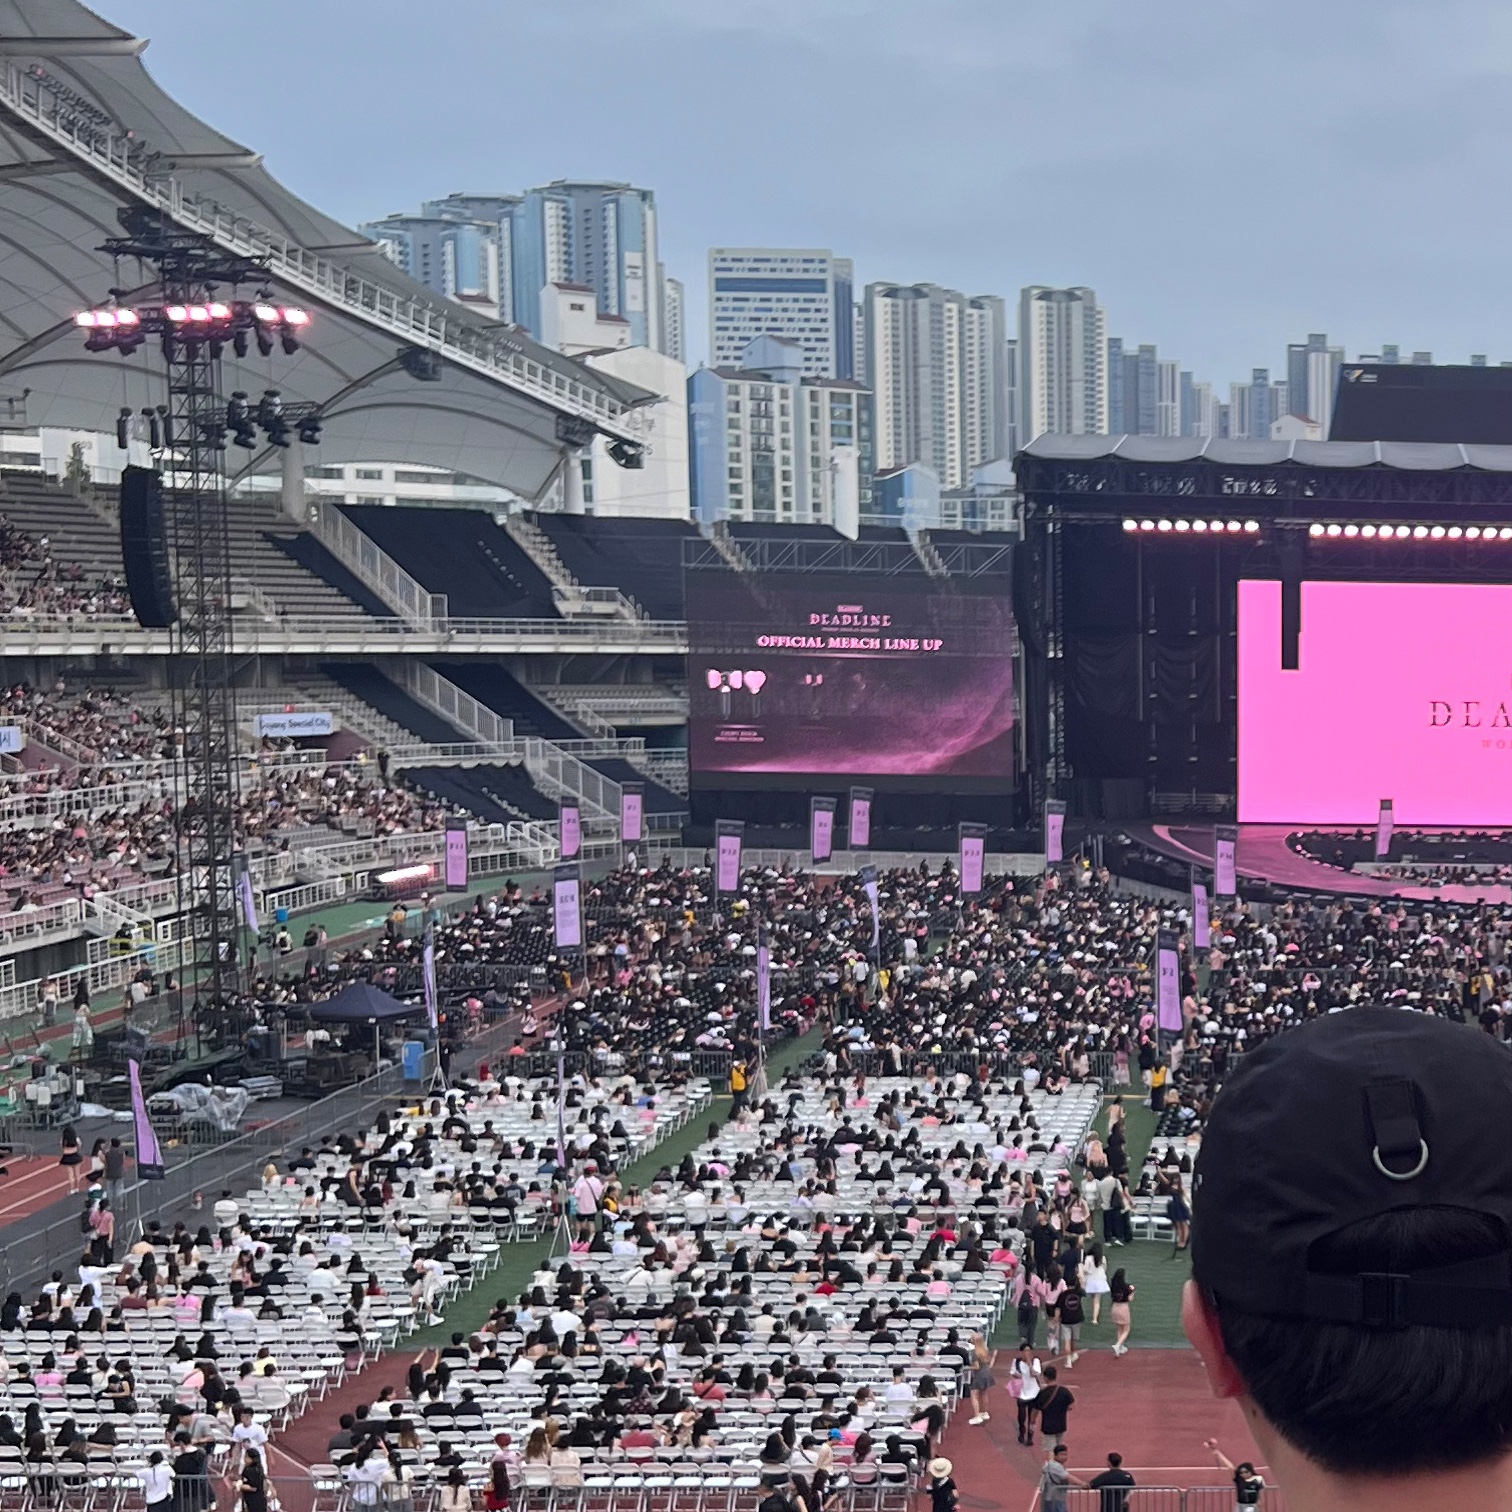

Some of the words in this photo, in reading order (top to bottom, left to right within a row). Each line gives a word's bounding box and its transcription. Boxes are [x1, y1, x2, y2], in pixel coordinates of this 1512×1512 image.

[809, 614, 892, 627] DEADLINE
[757, 635, 826, 649] OFFICIAL
[827, 636, 881, 650] MERCH
[884, 638, 920, 651] LINE
[923, 638, 943, 651] UP
